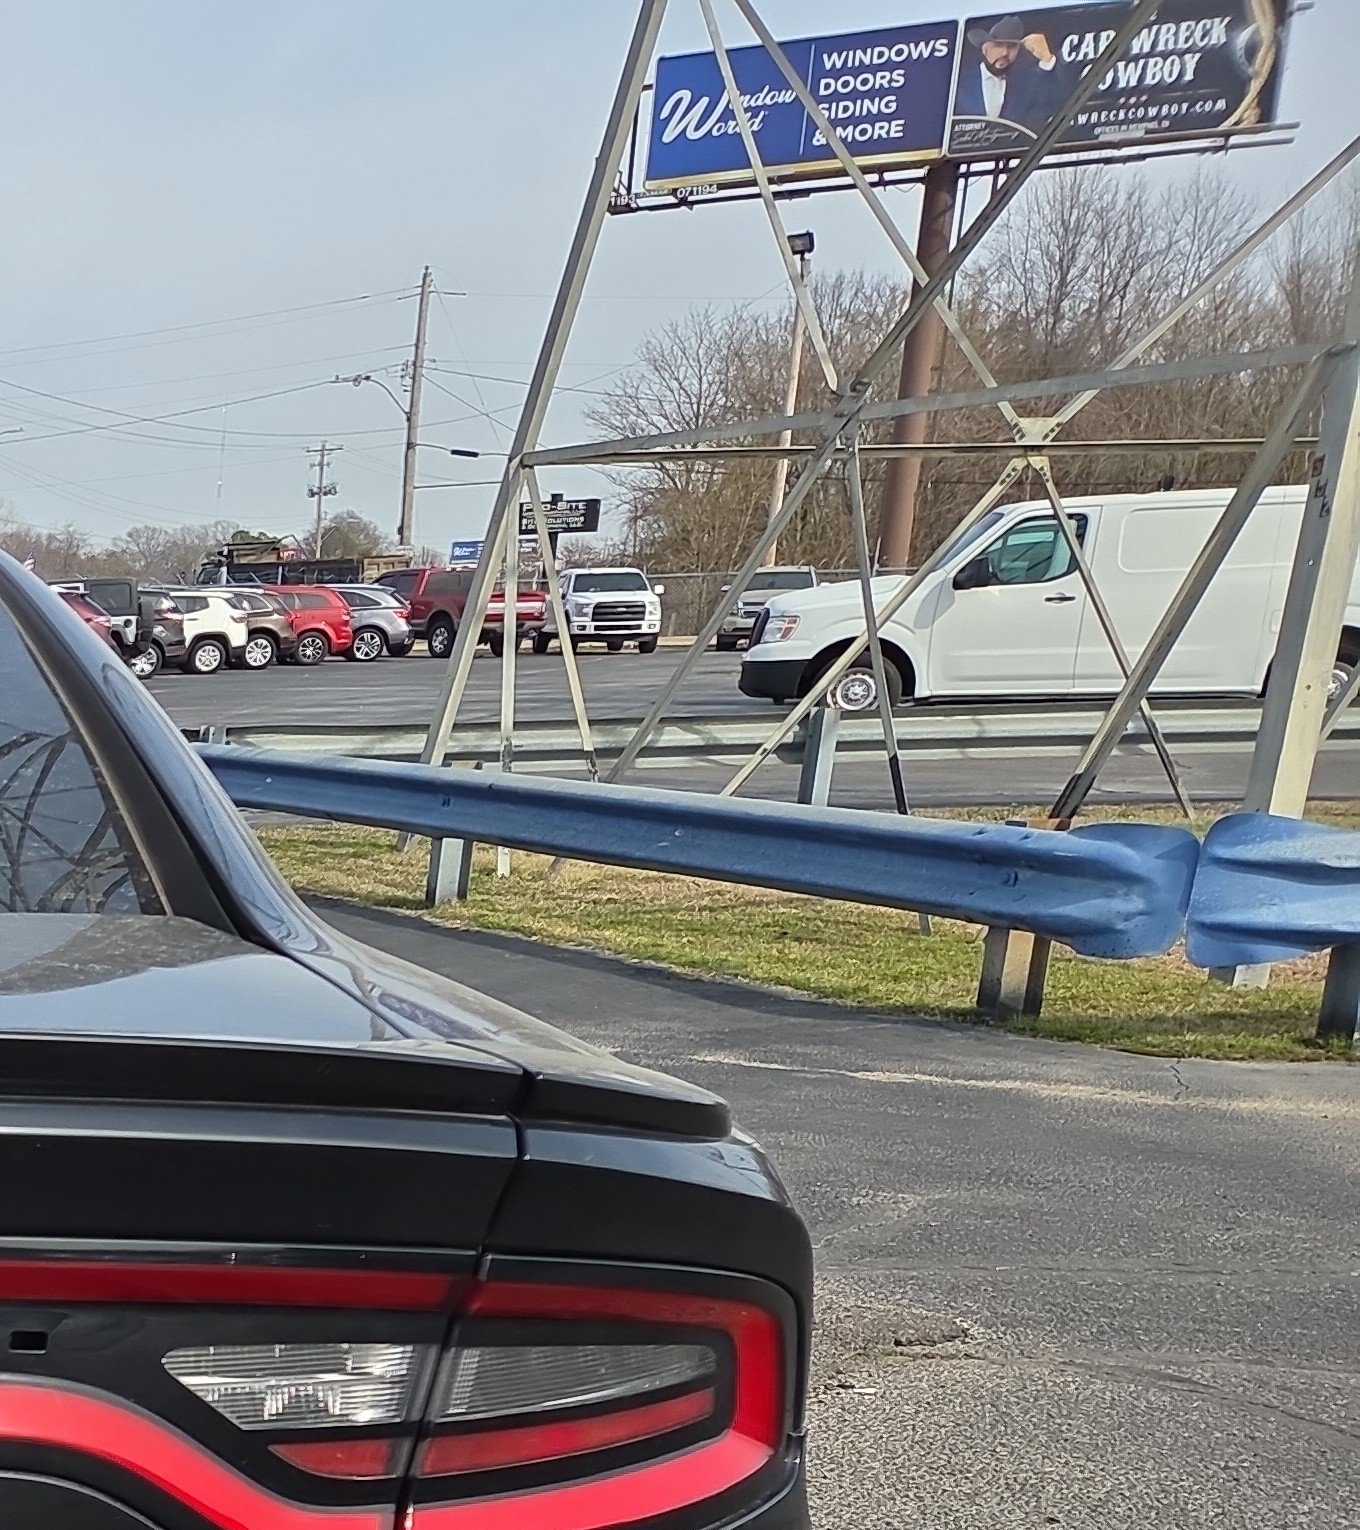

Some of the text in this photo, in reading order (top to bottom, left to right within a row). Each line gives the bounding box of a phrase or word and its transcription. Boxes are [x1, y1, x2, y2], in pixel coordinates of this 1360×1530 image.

[1130, 16, 1231, 55] WRECK
[822, 38, 949, 70] WINDOWS
[819, 69, 905, 96] DOORS
[1080, 52, 1202, 91] OWBOY
[660, 84, 797, 143] Wndow
[817, 95, 897, 121] SIDING
[836, 120, 905, 143] MORE
[677, 184, 718, 198] 071194
